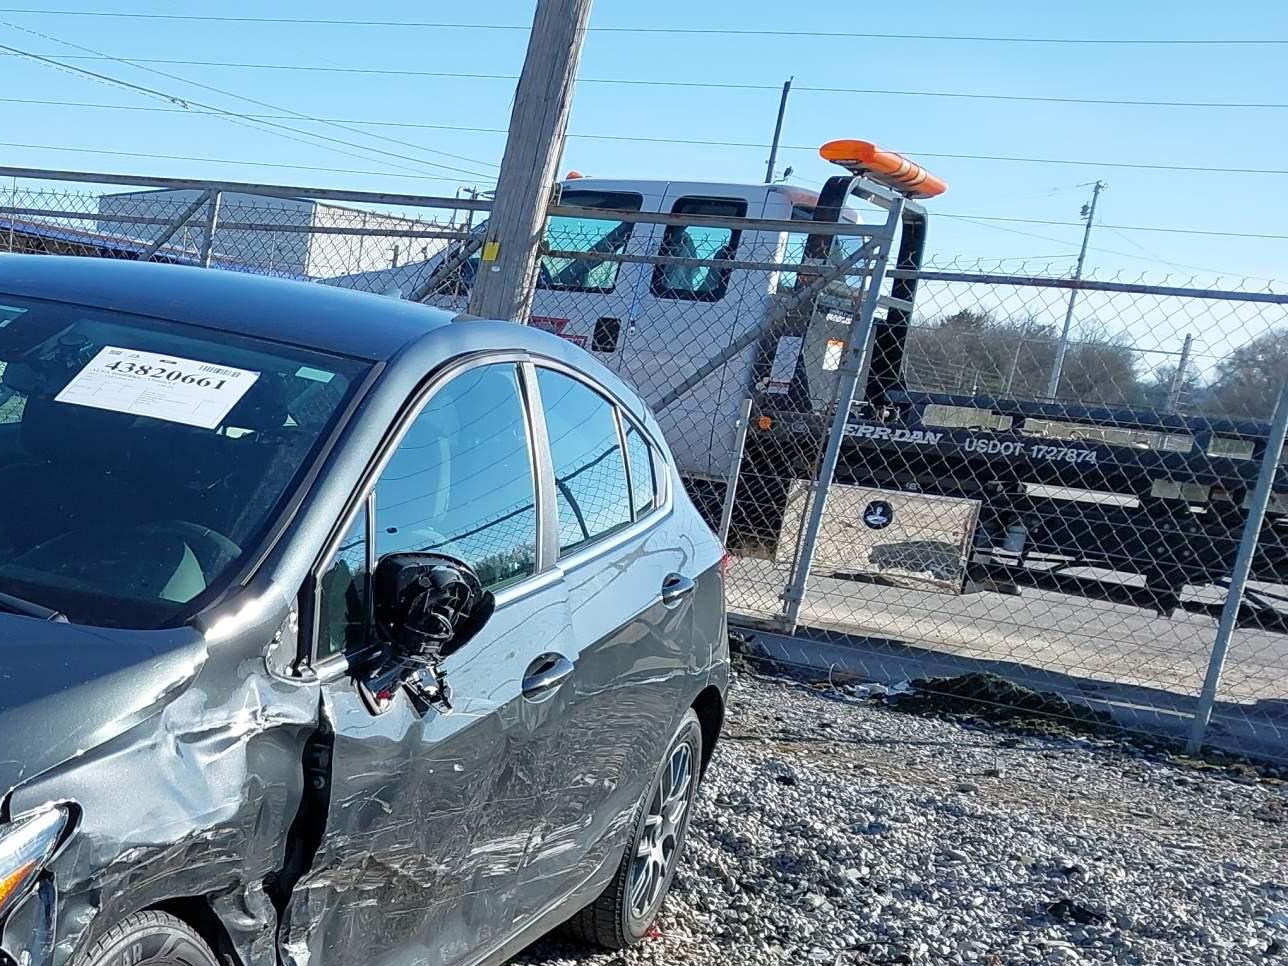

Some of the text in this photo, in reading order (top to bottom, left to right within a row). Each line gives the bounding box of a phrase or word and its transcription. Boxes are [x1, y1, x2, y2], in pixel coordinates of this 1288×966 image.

[105, 360, 228, 390] 43820661
[828, 423, 943, 445] ERR-DAN
[964, 438, 1098, 464] USDOT 1727874
